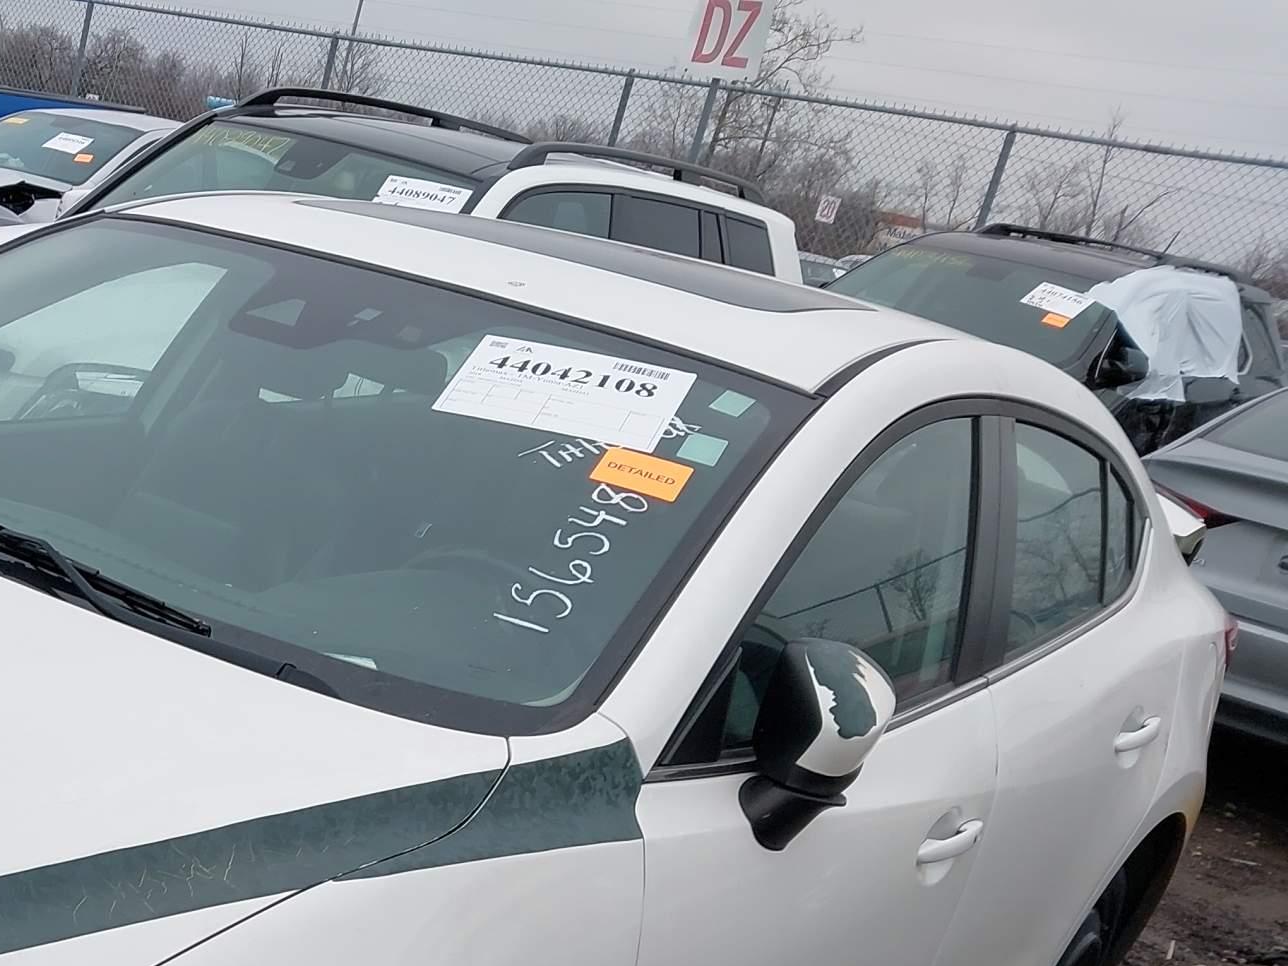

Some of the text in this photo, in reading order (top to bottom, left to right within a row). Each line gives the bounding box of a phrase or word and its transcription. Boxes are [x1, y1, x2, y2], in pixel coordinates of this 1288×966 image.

[691, 0, 763, 68] DZ
[388, 185, 456, 205] 44089047
[489, 356, 658, 399] 44042108
[607, 461, 676, 486] DETAILED
[493, 484, 649, 632] 156548
